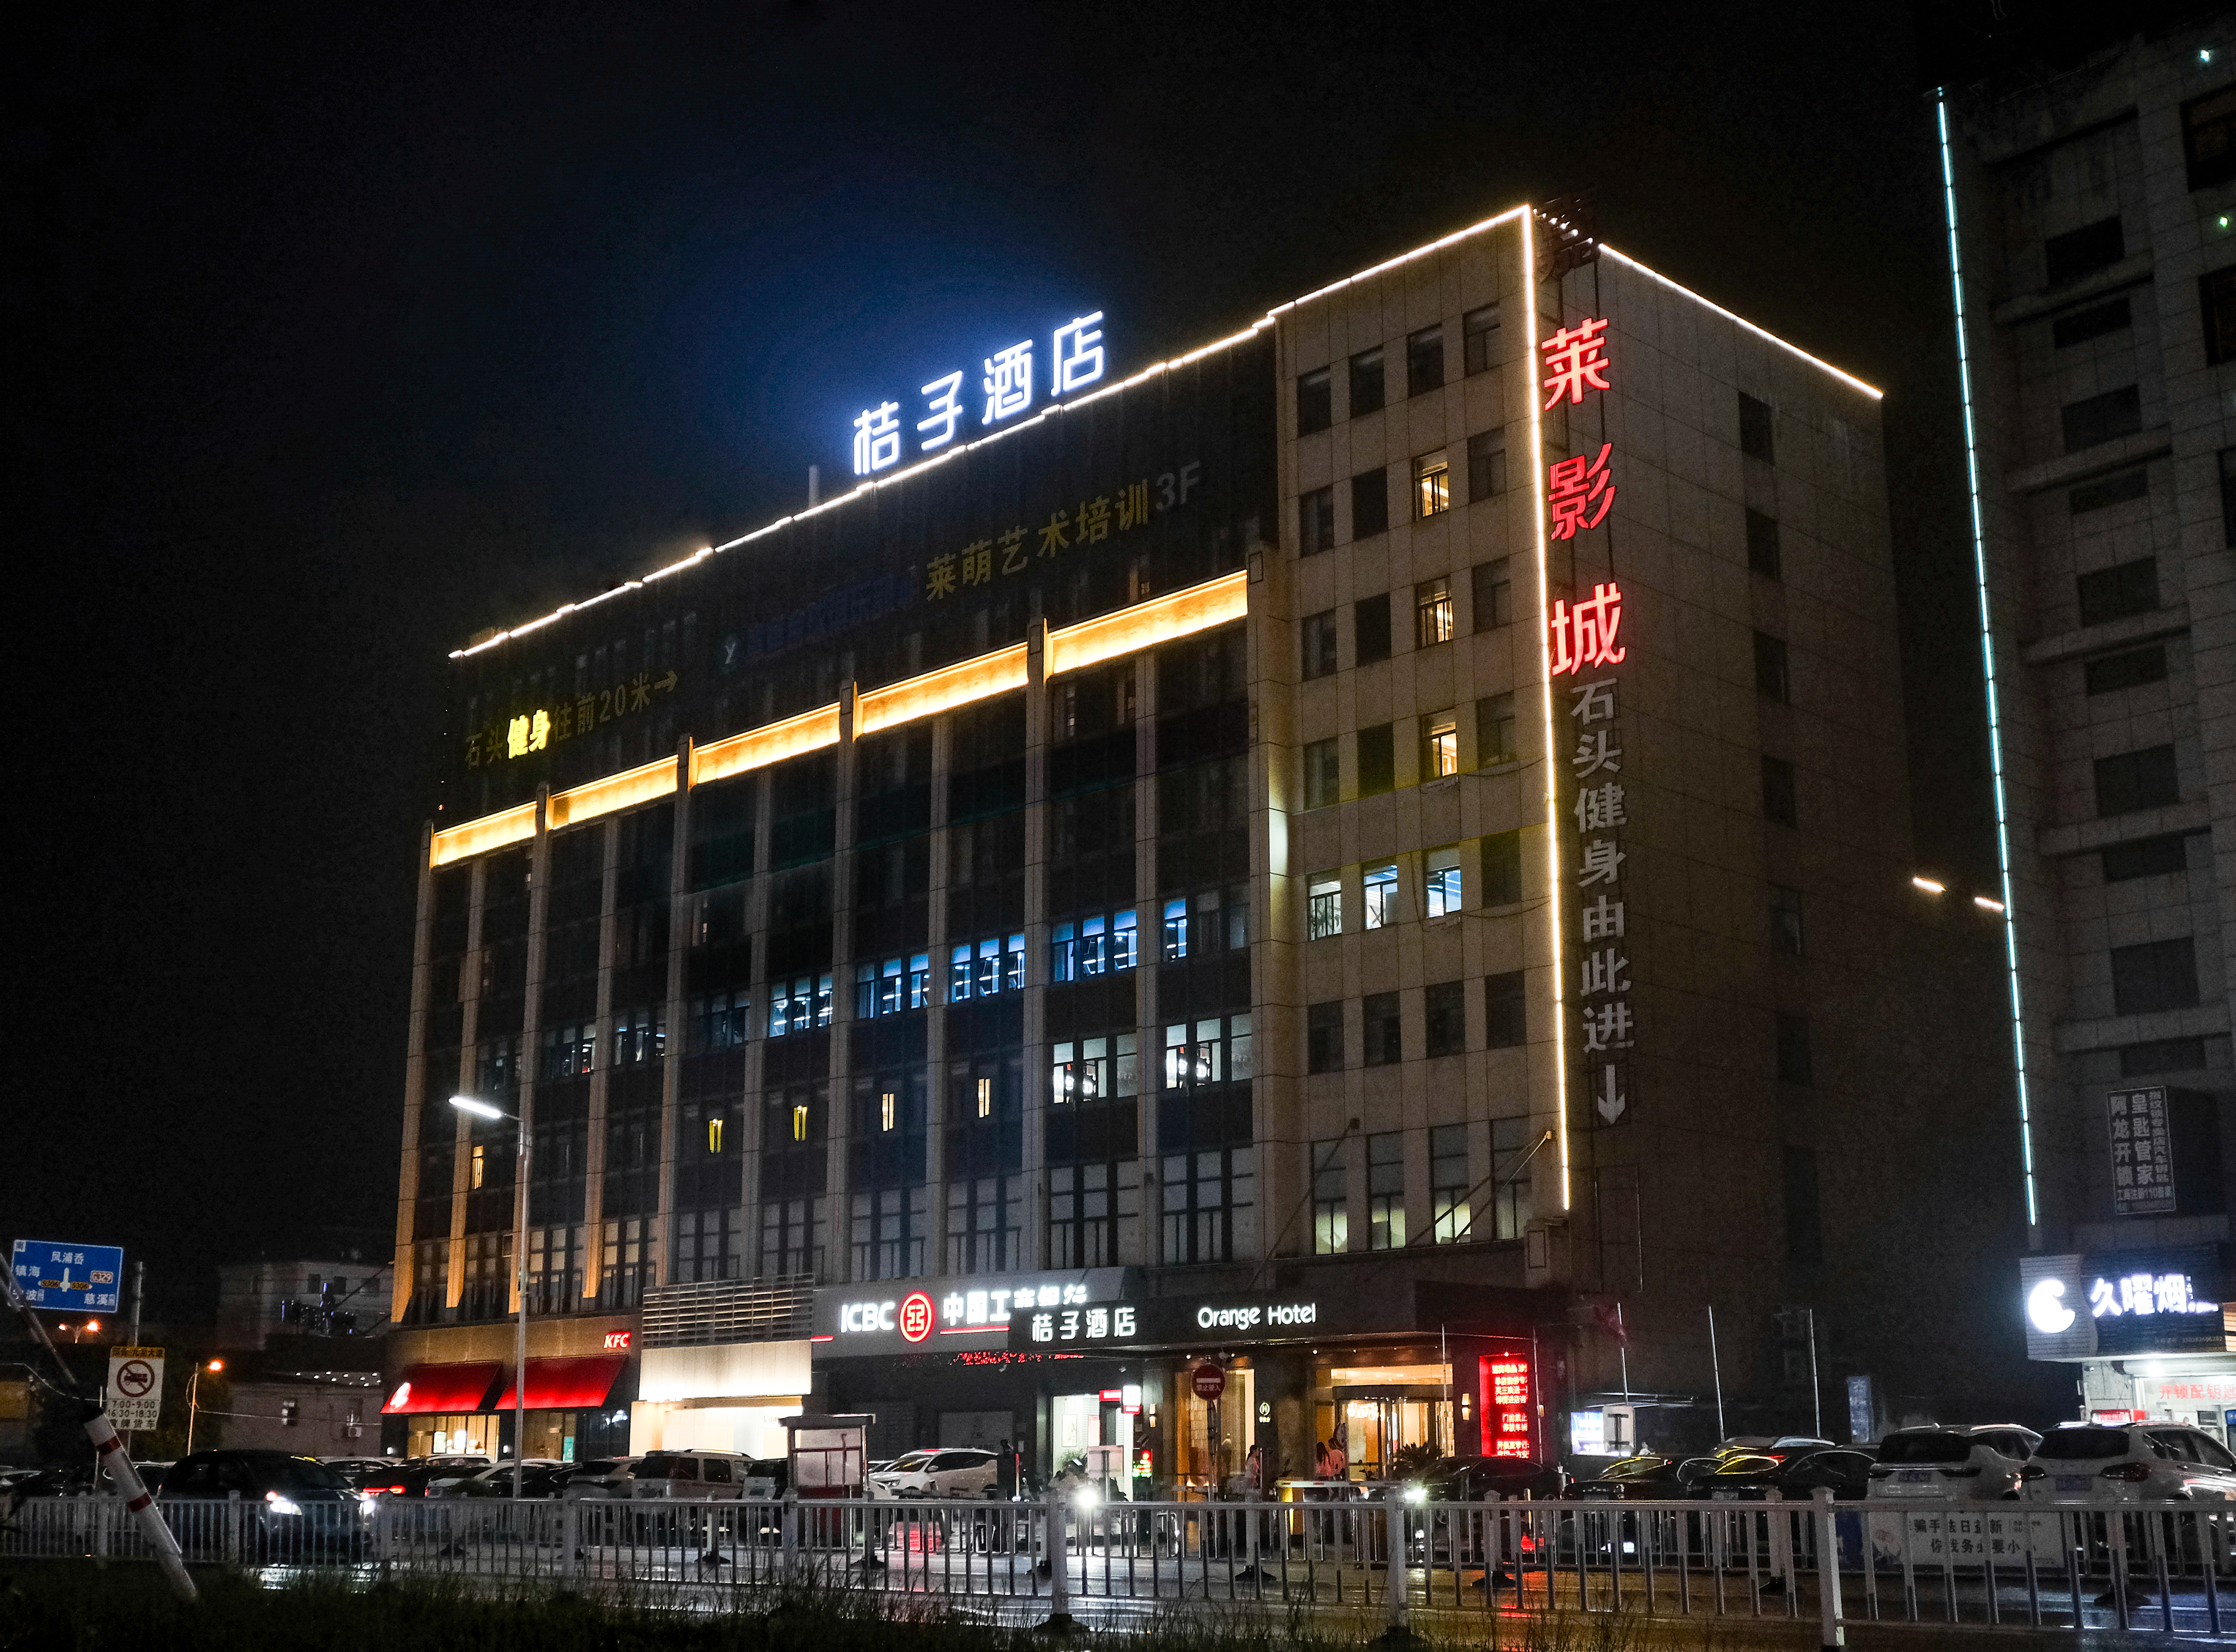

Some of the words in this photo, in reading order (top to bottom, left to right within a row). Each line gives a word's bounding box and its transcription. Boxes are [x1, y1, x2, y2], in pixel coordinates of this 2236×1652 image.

[853, 310, 1105, 476] 桔子酒店
[1541, 317, 1626, 676] 莱影城
[1570, 678, 1635, 1053] 石头健身由此进
[841, 1301, 895, 1333] ICBC
[1032, 1306, 1137, 1342] 桔子酒店
[1198, 1306, 1260, 1330] Orange
[1268, 1302, 1317, 1326] Hotel
[603, 1333, 630, 1348] KFC
[2159, 1384, 2236, 1400] 开锁配钥匙
